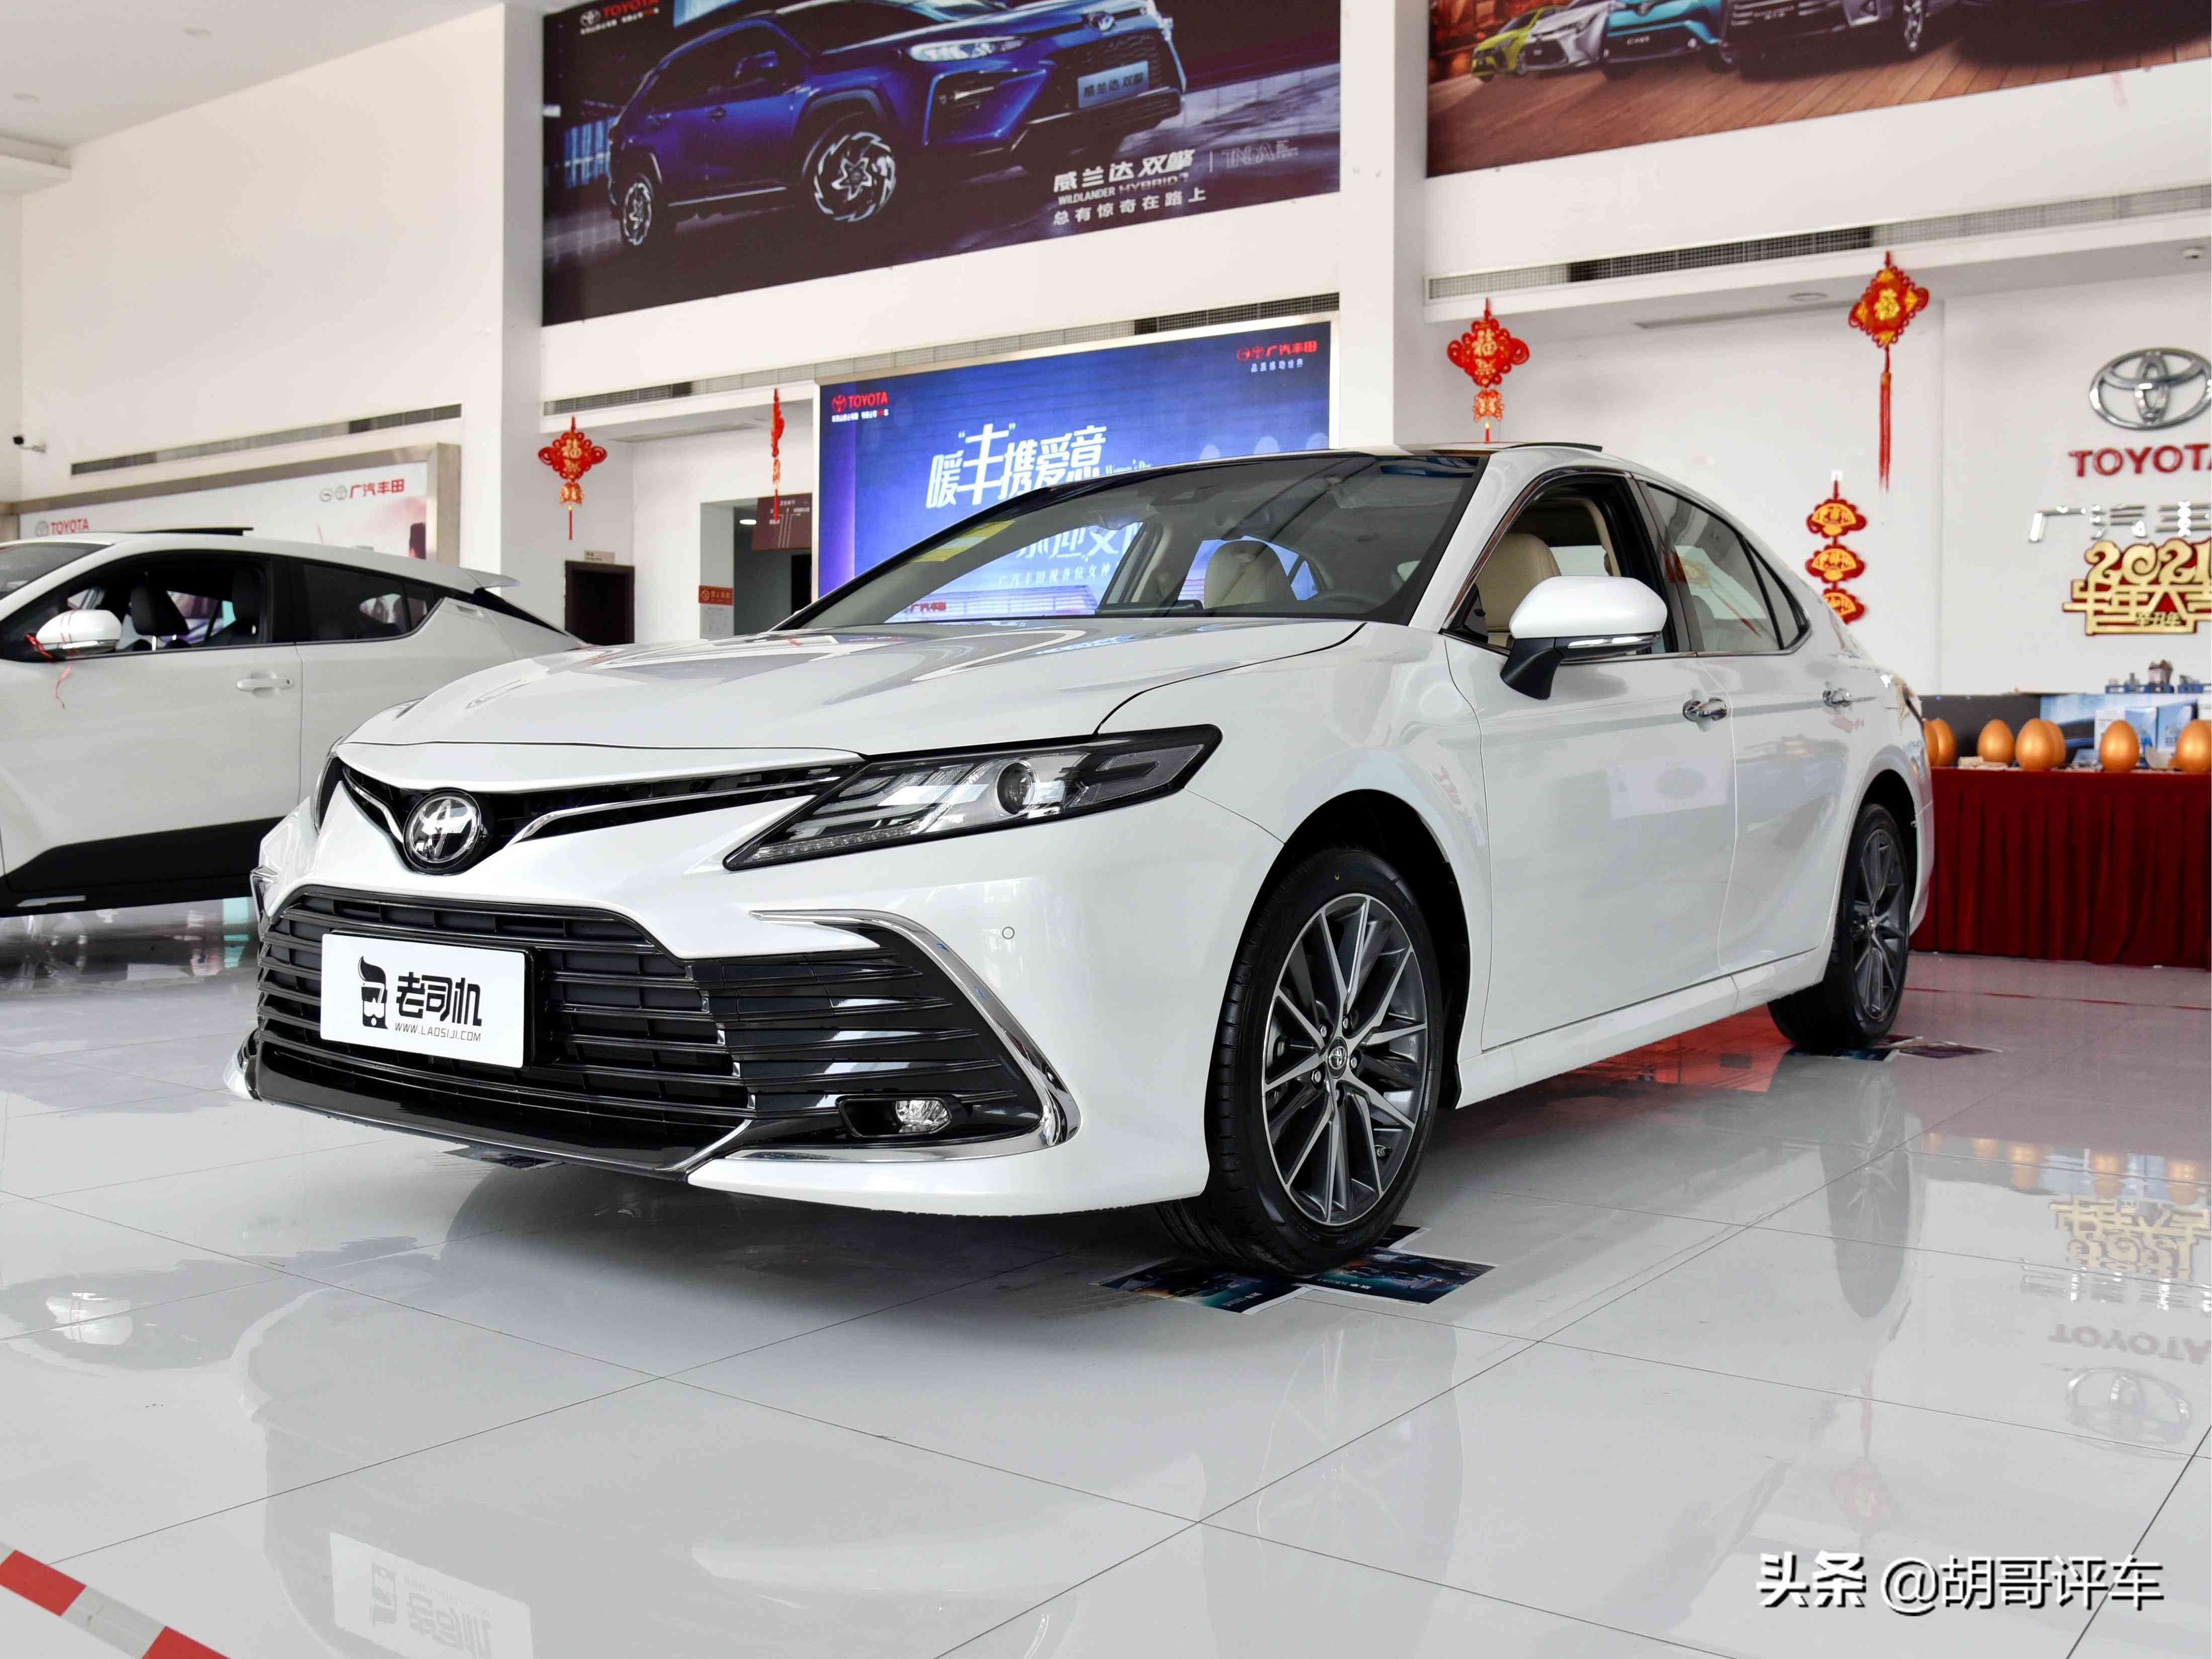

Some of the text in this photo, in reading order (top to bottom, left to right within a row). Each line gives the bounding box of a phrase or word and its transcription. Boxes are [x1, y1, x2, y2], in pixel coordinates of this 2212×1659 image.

[1058, 175, 1179, 206] WILDLANDER HYBRID
[1053, 187, 1207, 226] 总有惊奇在路上
[849, 391, 888, 409] TOYOTA
[2068, 443, 2211, 477] TOYOT
[350, 479, 405, 499] 广汽丰田
[51, 518, 89, 534] TOYOTA
[396, 971, 482, 1027] 老司机
[395, 1021, 482, 1042] WWW.LAOSIJI.COM
